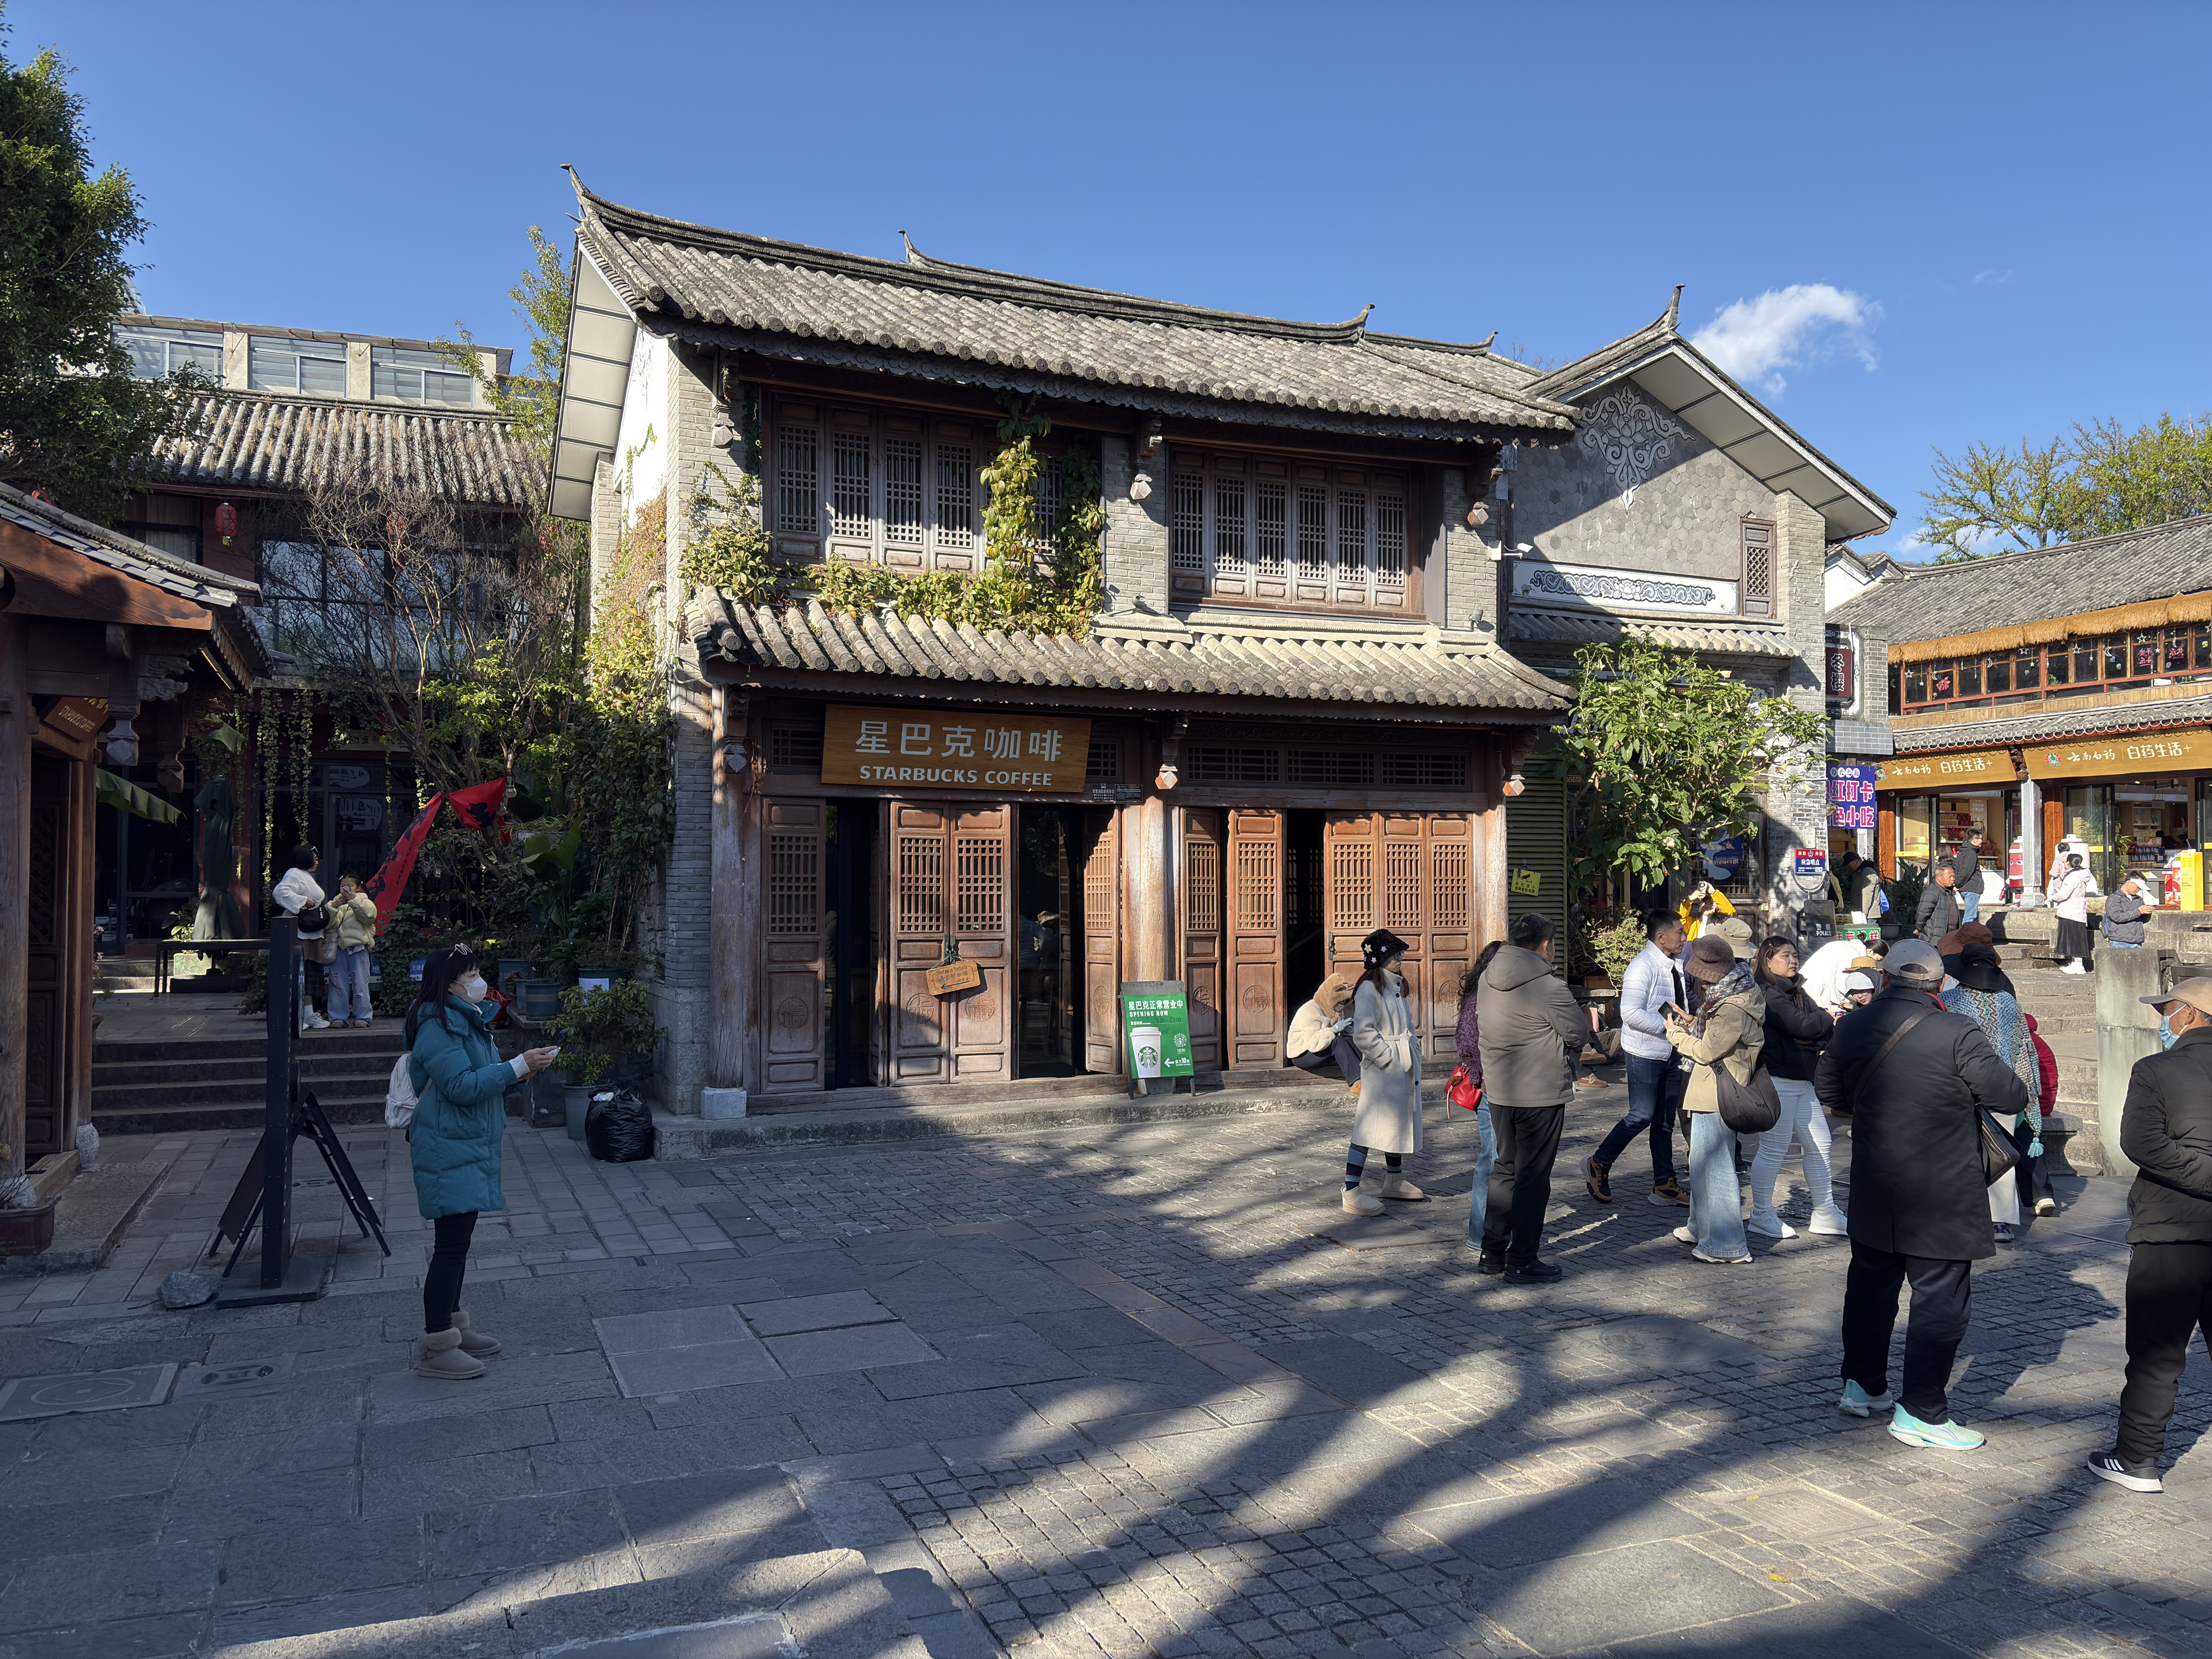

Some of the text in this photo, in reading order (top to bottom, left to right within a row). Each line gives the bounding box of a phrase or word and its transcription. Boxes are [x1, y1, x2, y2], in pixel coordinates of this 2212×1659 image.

[855, 720, 1063, 761] 星巴克咖啡
[2067, 748, 2116, 762] 云南白药
[859, 765, 1052, 785] STARBUCKS COFFEE
[1892, 764, 1931, 776] 云南白药
[1128, 999, 1183, 1010] 星巴克正常营业中
